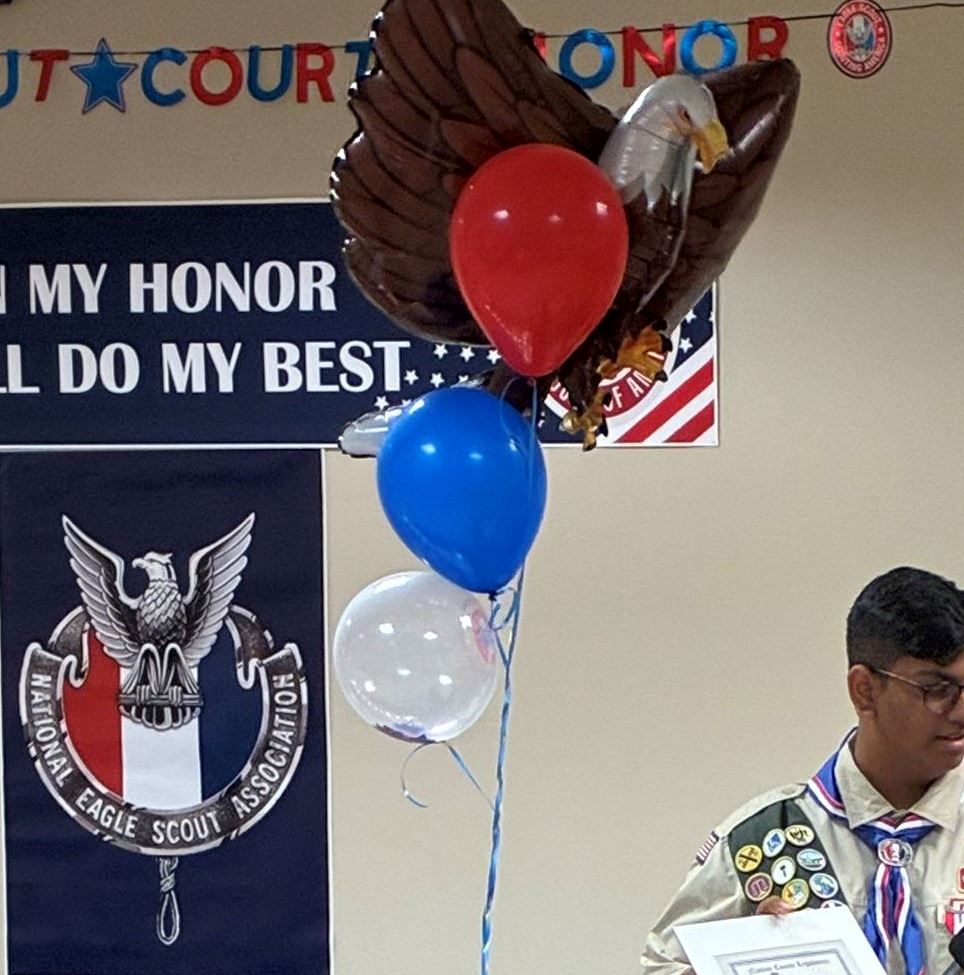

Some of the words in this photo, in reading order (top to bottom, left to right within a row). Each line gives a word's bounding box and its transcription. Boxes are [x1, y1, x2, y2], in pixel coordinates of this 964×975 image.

[533, 16, 789, 89] ONOR
[29, 263, 107, 314] MY
[129, 260, 338, 314] HONOR
[0, 343, 40, 394] L
[57, 341, 141, 394] DO
[161, 341, 242, 394] MY
[262, 340, 411, 394] BEST
[30, 672, 73, 787] NATIONAL
[74, 786, 139, 839] EAGLE
[152, 808, 223, 845] SCOUT
[230, 672, 296, 820] ASSOCIATION
